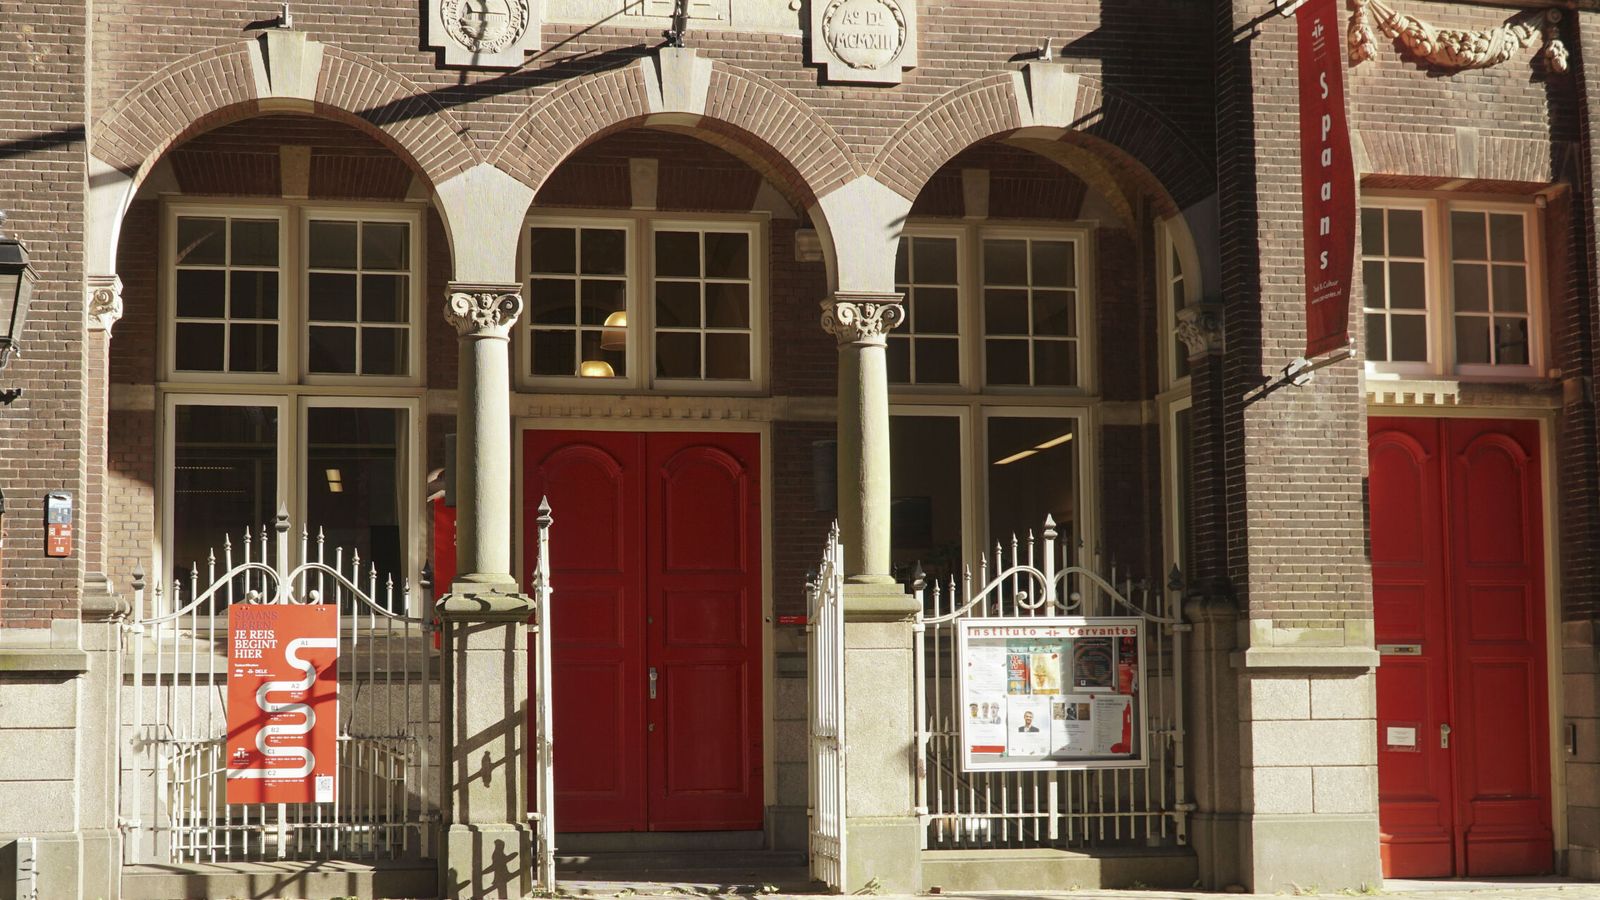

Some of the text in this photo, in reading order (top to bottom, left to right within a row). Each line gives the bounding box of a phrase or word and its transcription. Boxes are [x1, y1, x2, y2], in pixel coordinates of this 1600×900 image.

[833, 33, 893, 50] MCMXIII
[1320, 72, 1331, 270] Spaans
[235, 610, 279, 620] SPAANS
[235, 630, 274, 639] JE REIS
[967, 626, 1137, 636] Instituto Cervantes
[234, 639, 278, 649] BEGINT
[234, 649, 263, 659] HIER
